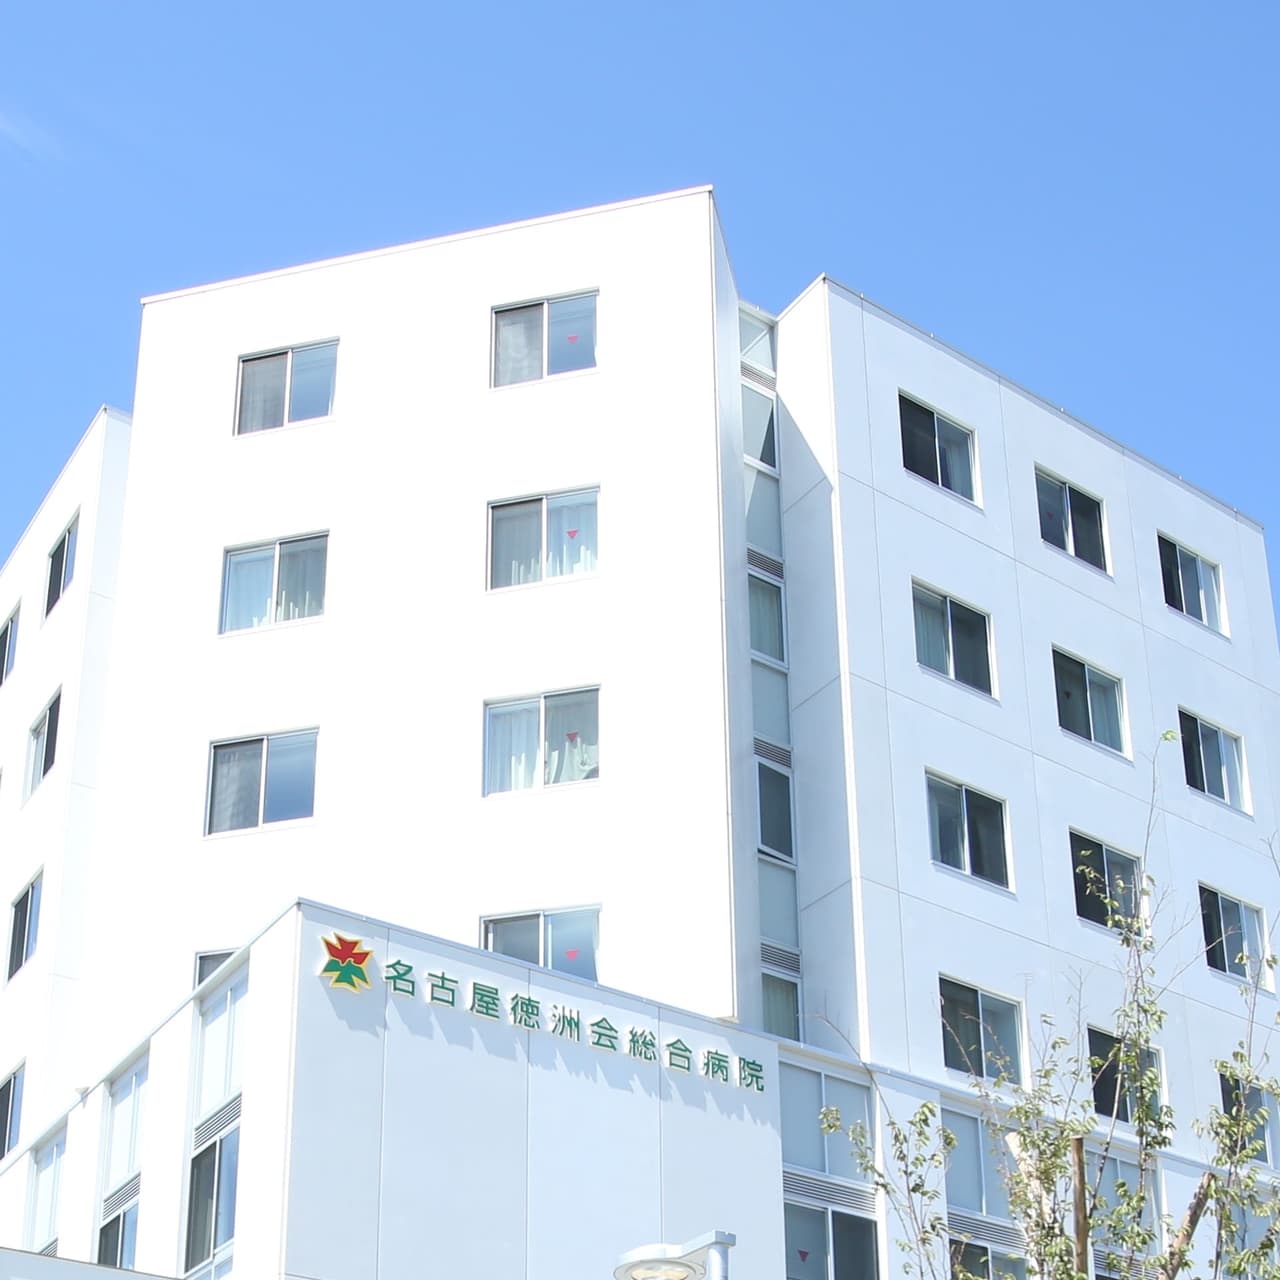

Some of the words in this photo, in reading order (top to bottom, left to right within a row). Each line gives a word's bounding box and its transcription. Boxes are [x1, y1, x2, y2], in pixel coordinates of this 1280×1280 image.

[384, 958, 766, 1093] 名古屋徳洲会総合病院
